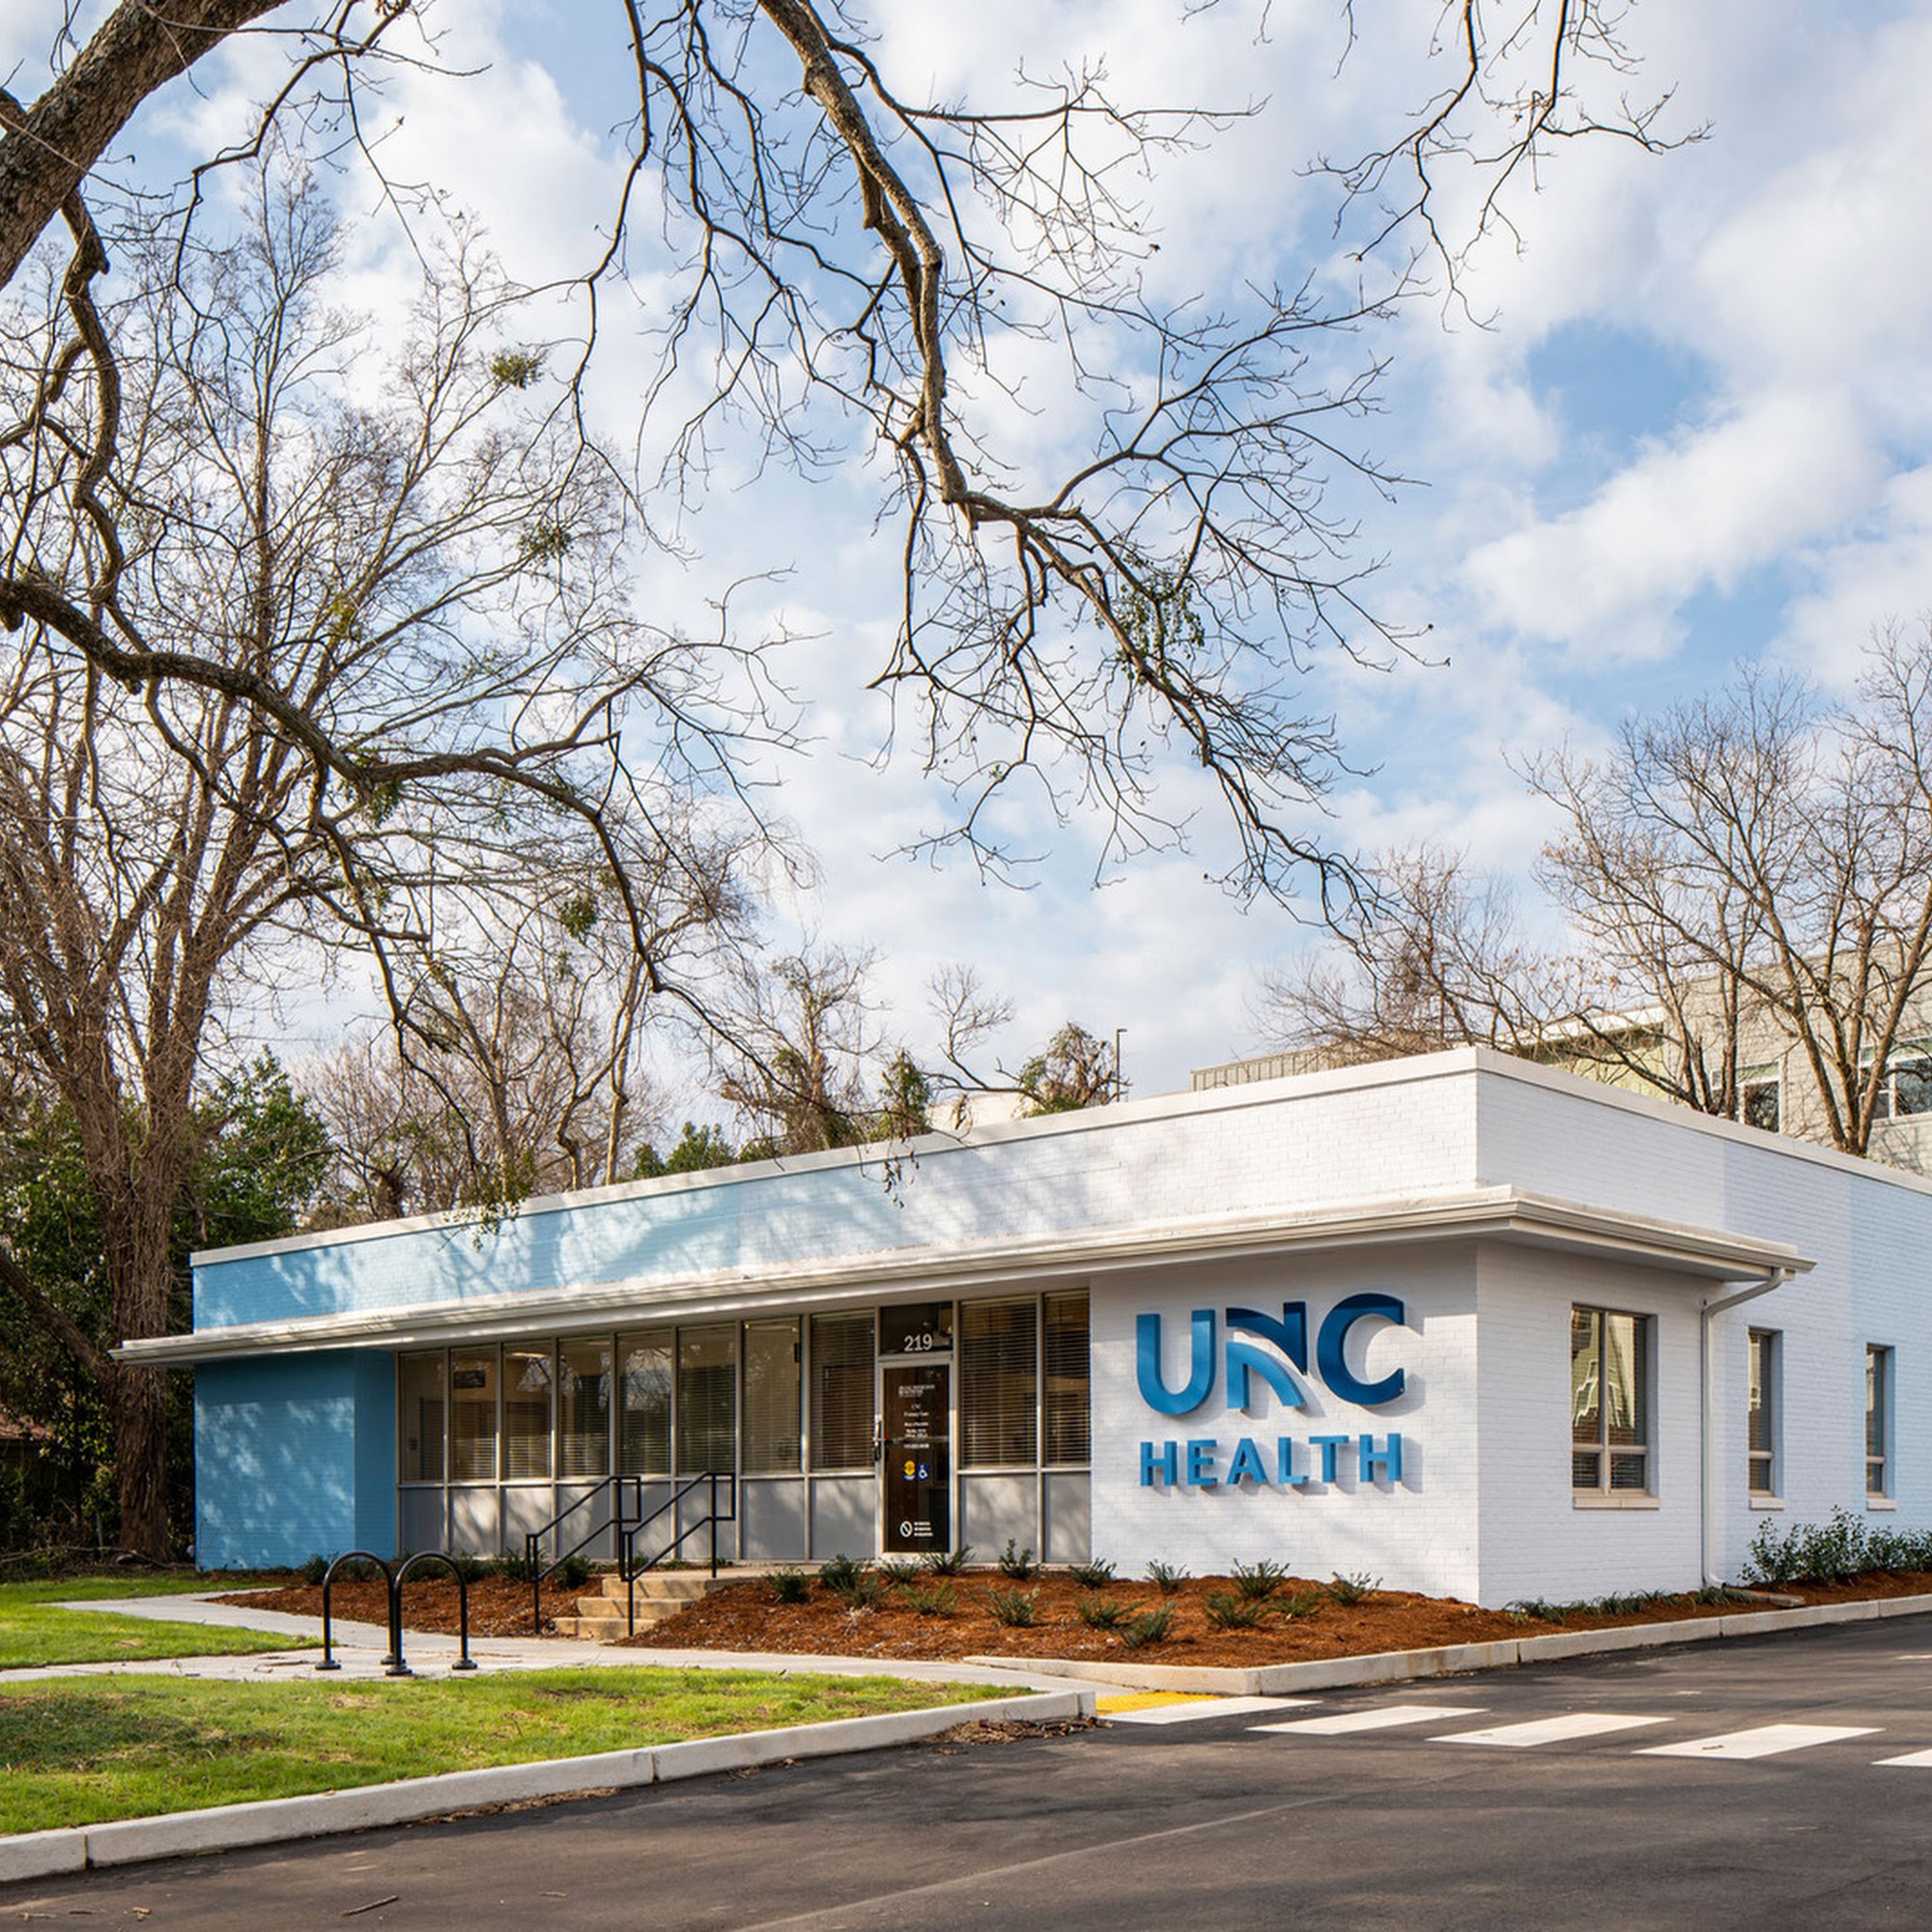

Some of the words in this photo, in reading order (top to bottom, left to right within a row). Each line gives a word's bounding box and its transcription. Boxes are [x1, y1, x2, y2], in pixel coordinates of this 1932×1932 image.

[903, 1333, 933, 1351] 219
[1136, 1293, 1405, 1416] UNC
[1140, 1434, 1402, 1487] HEALTH
